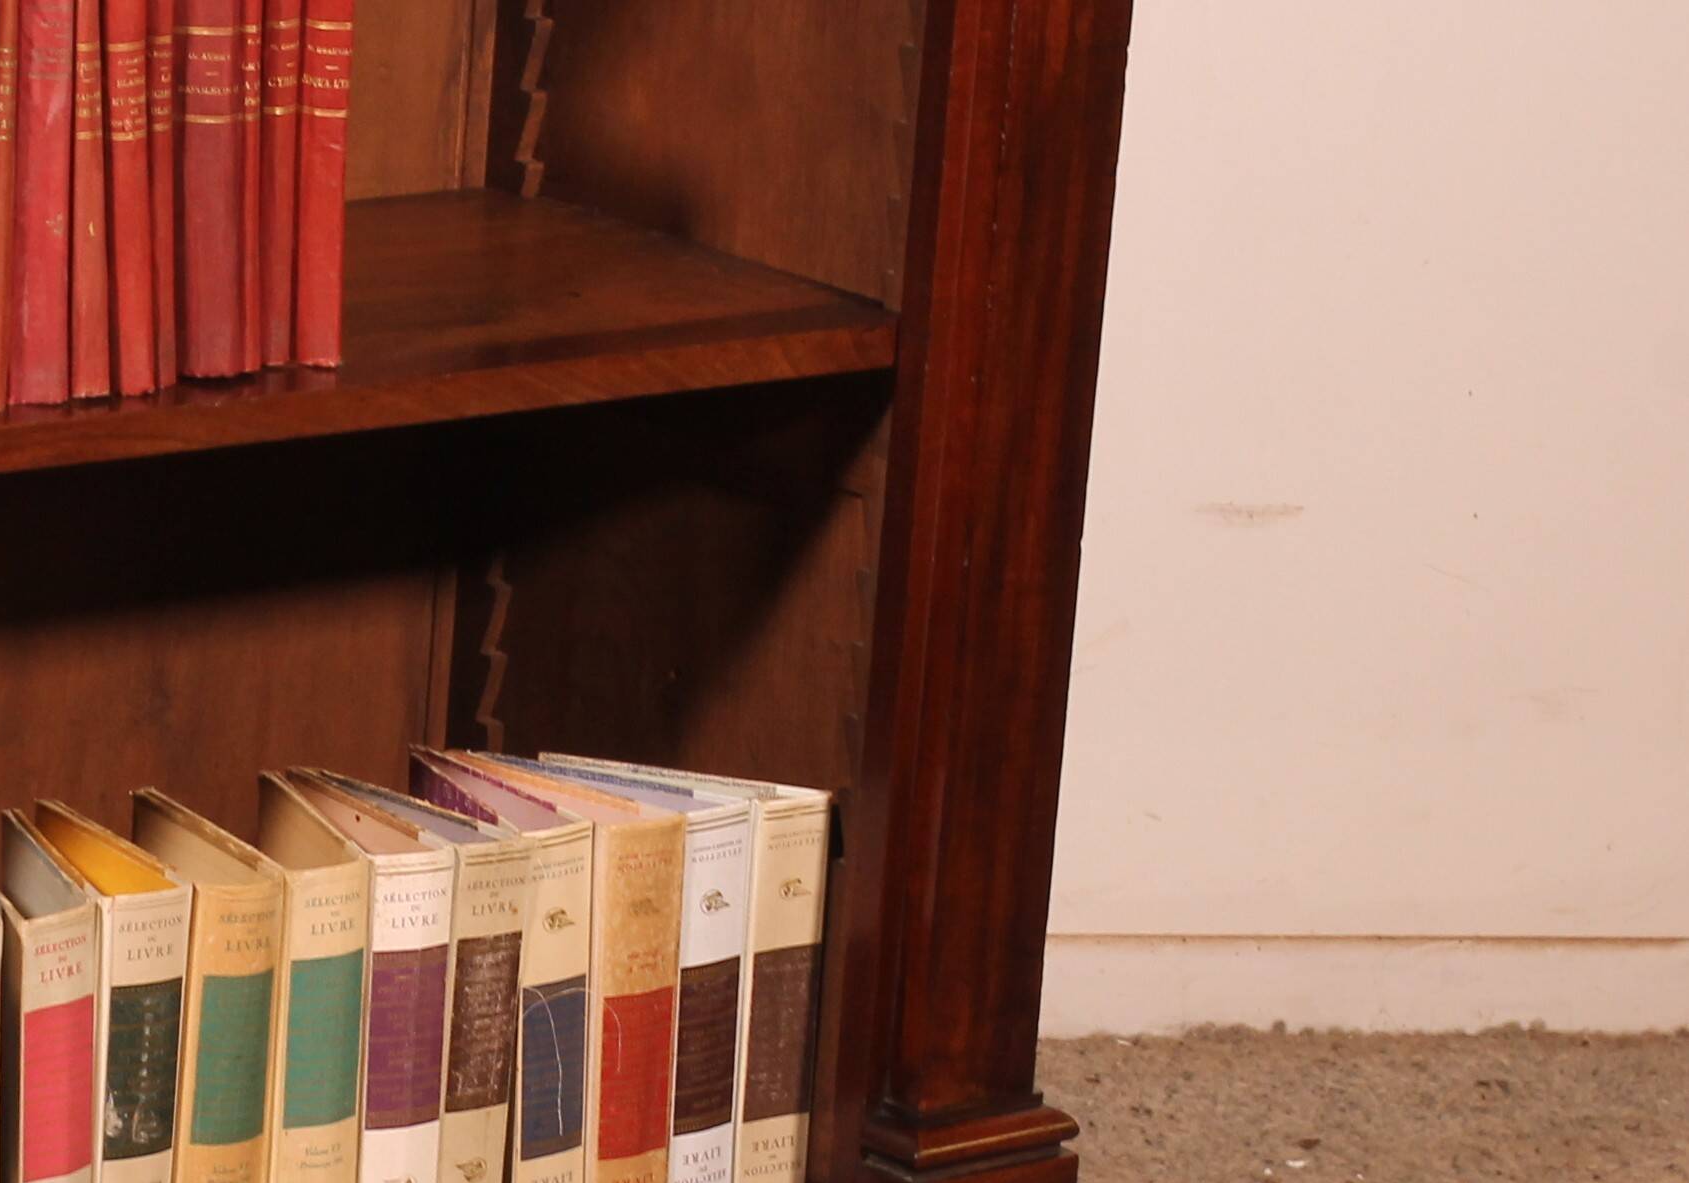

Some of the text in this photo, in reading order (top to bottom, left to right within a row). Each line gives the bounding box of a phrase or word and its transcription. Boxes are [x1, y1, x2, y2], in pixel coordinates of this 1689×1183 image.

[311, 918, 356, 936] LIVRE
[392, 913, 438, 929] LIVRE
[127, 944, 174, 961] LIVRE
[40, 961, 84, 984] LIVRE
